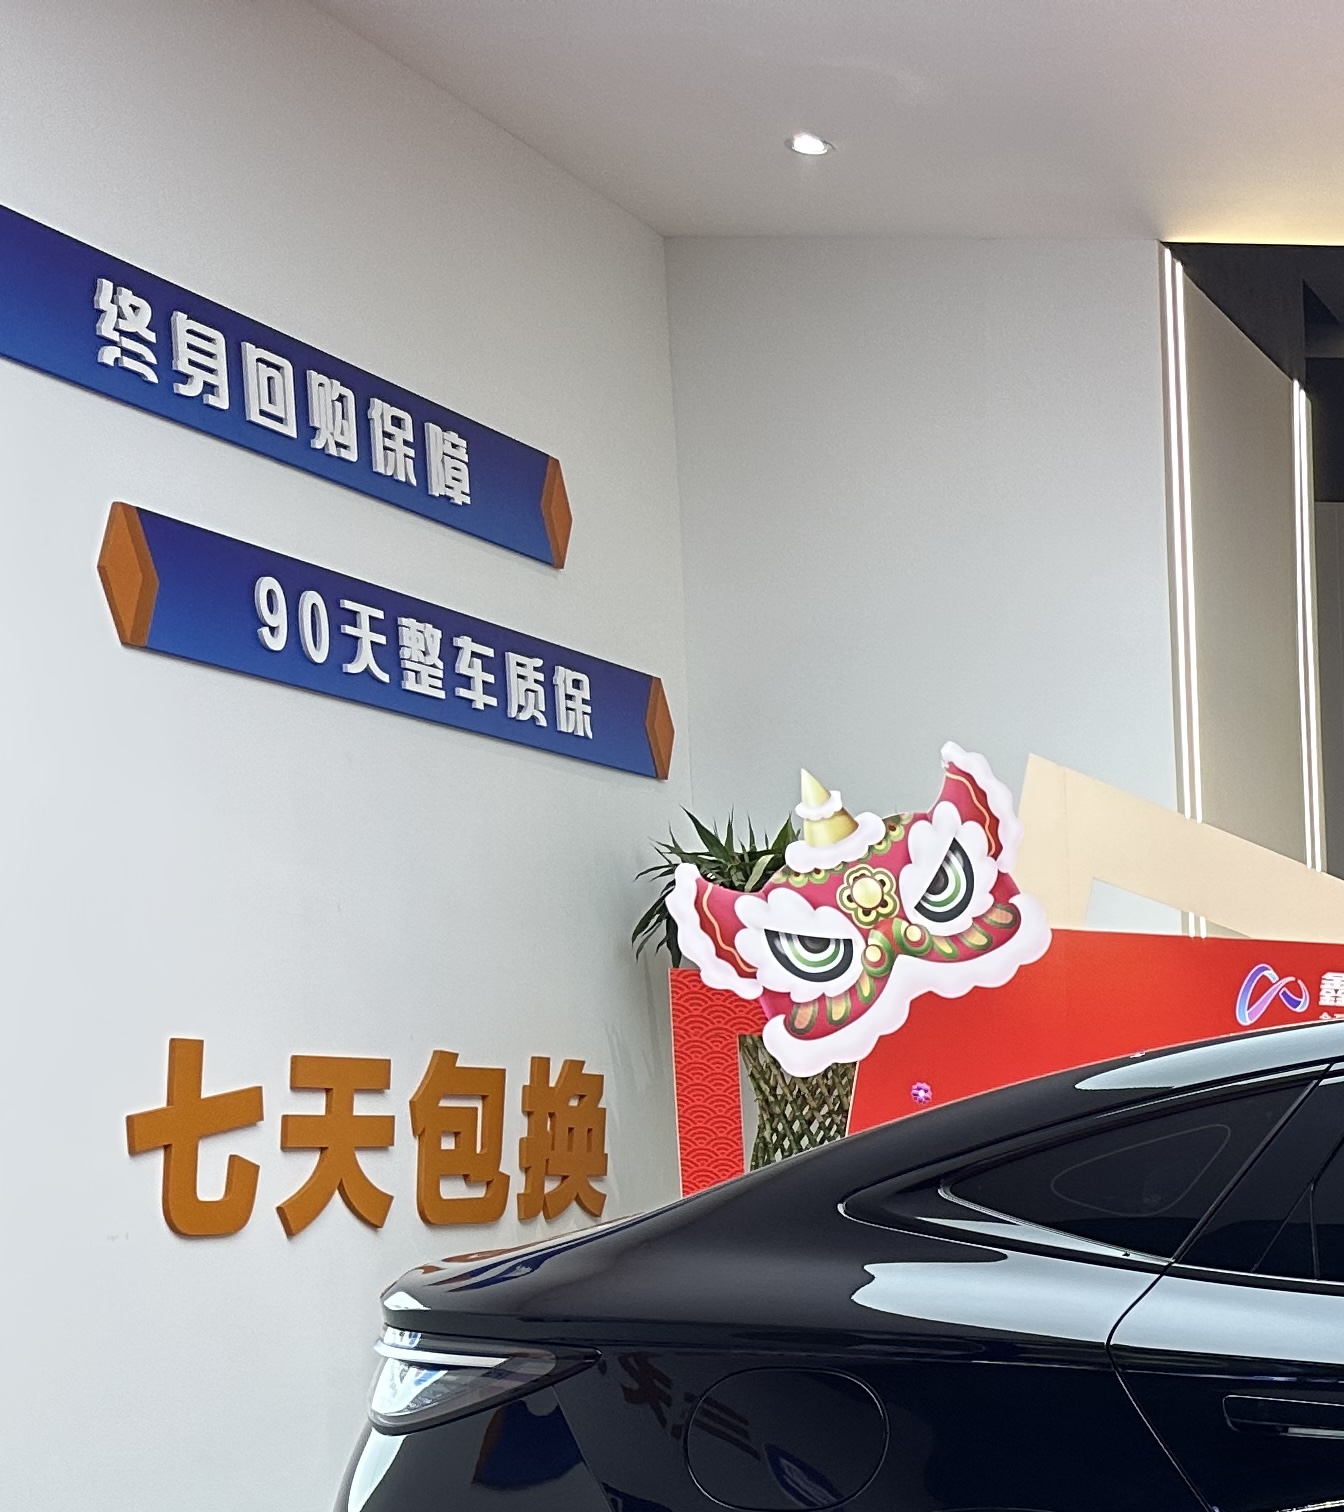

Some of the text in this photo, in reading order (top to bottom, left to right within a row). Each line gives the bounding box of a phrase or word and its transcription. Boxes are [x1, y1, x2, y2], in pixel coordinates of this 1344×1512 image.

[94, 277, 471, 507] 终身回购保障
[254, 576, 593, 739] 90天整车质保
[126, 1037, 608, 1237] 七天包换
